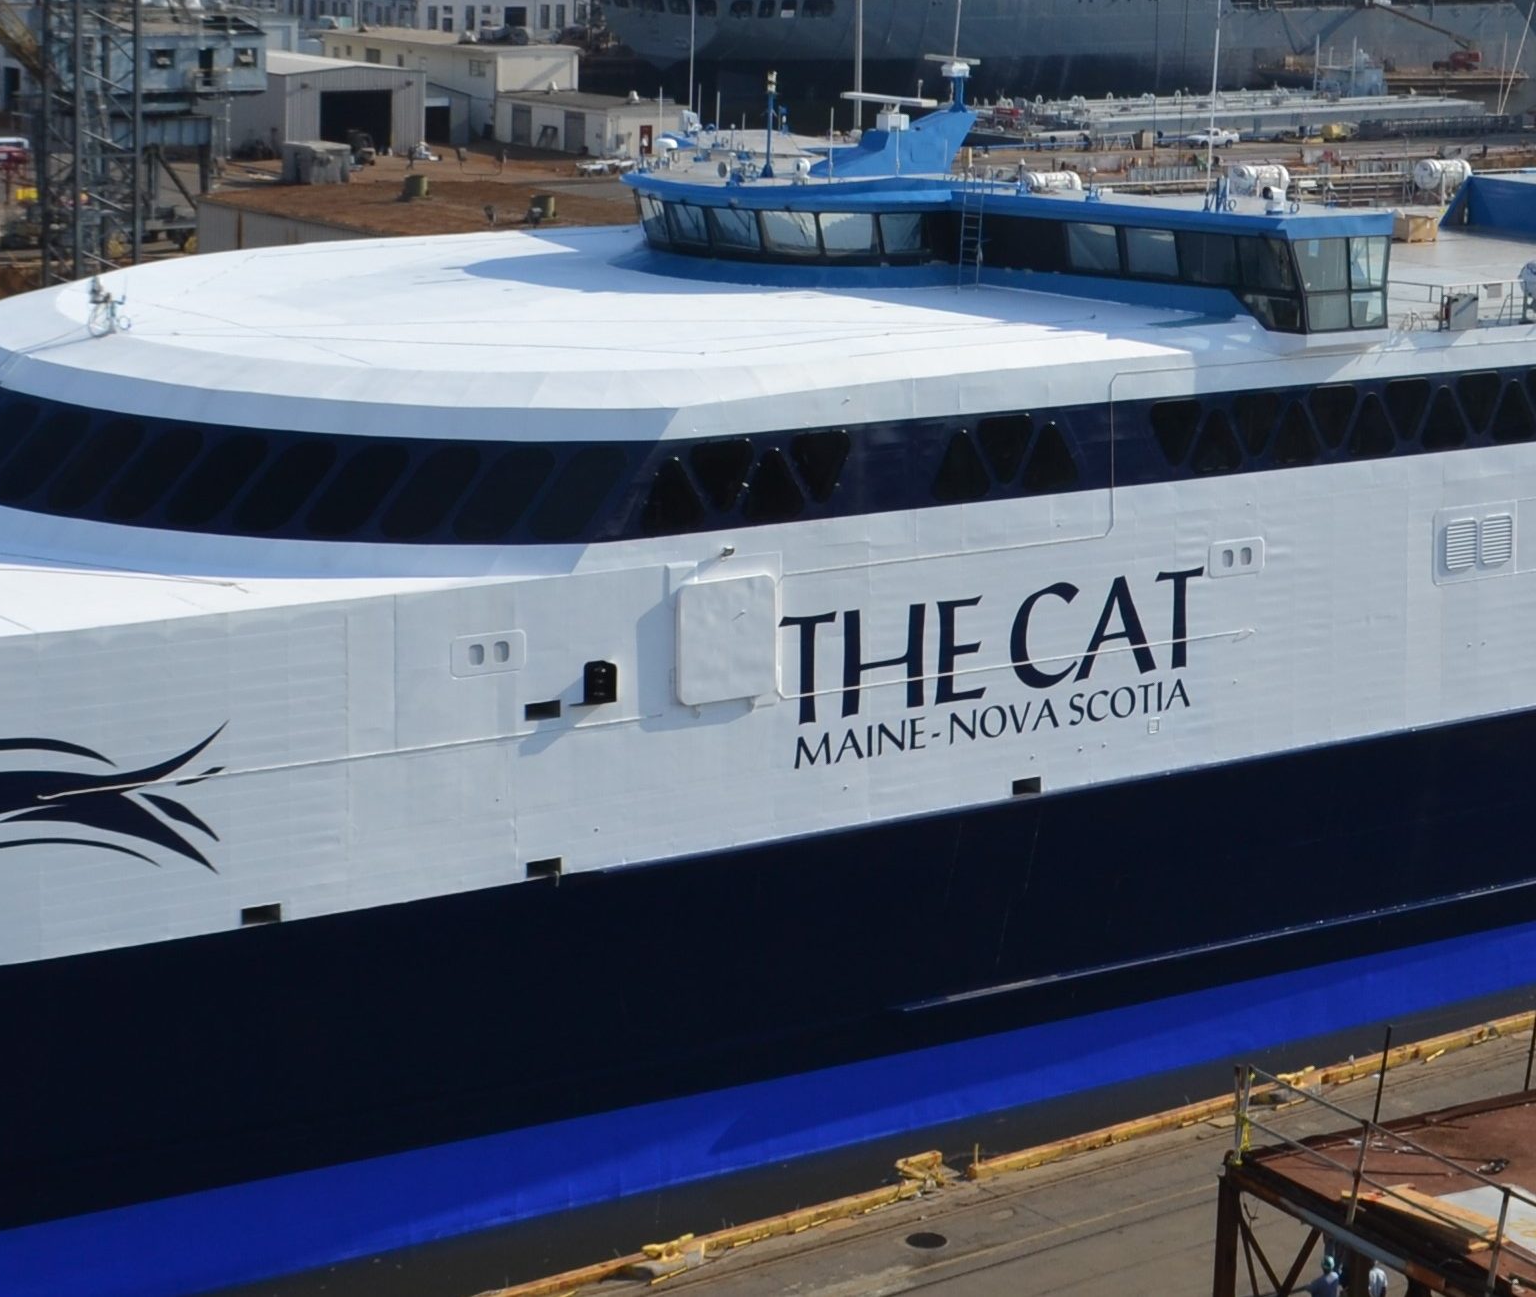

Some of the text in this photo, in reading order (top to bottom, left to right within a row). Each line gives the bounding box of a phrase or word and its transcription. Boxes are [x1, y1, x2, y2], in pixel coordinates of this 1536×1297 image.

[778, 565, 1205, 726] THE CAT
[1068, 678, 1191, 726] SCOTIA
